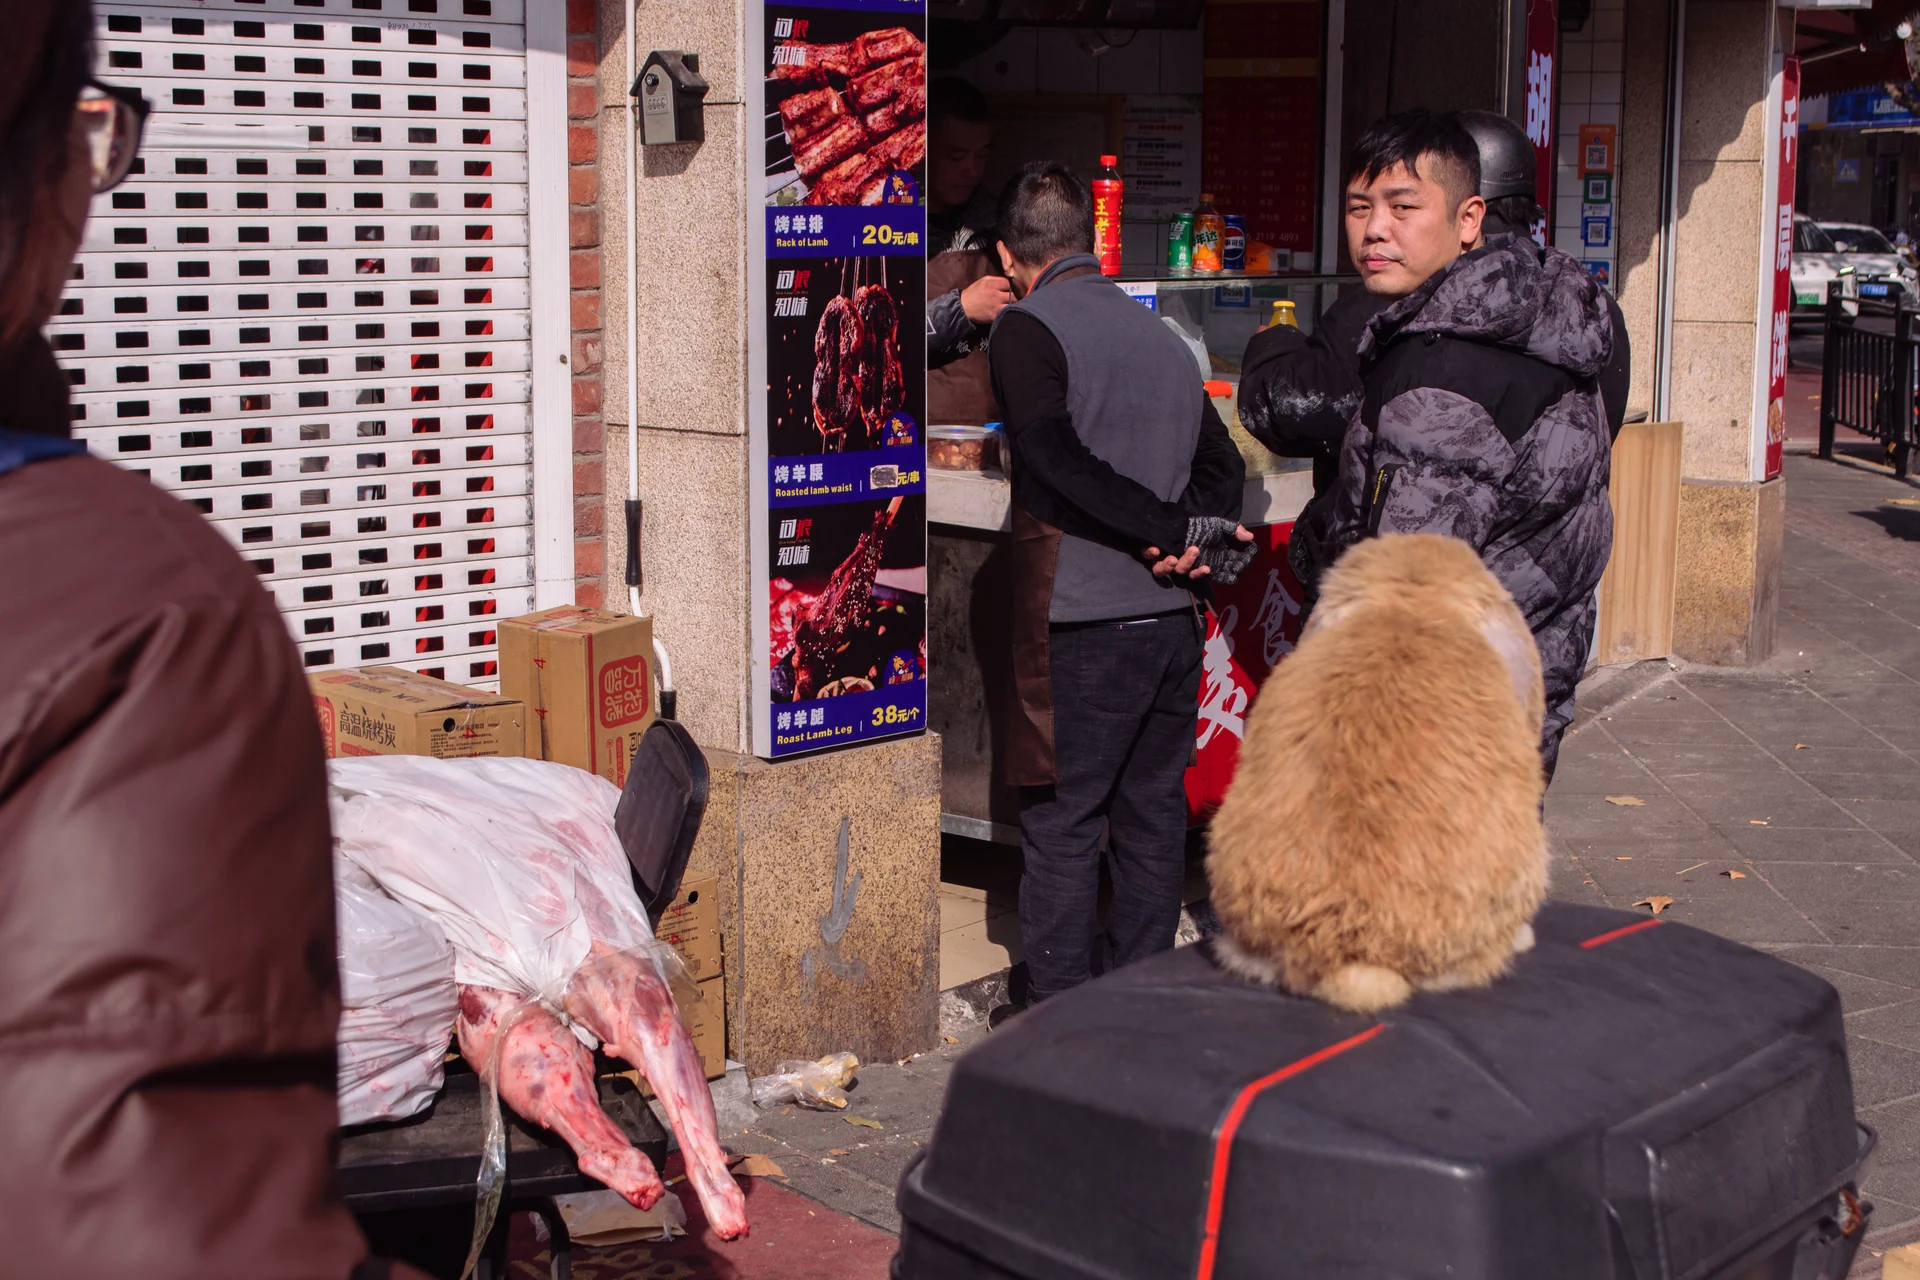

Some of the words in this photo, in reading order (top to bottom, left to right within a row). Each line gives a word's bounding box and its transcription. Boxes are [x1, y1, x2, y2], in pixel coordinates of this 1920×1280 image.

[774, 17, 809, 40] 问狼
[772, 45, 806, 66] 知味
[774, 214, 824, 234] 烤羊排
[776, 238, 796, 247] Rack
[798, 238, 806, 247] of
[807, 238, 828, 247] Lamb
[862, 224, 919, 246] 20元/串
[775, 270, 811, 294] 问狼
[773, 297, 808, 317] 知味
[774, 463, 824, 484] 烤羊腰
[897, 471, 920, 485] 元/串
[775, 486, 809, 497] Roasted
[810, 486, 830, 495] lamb
[831, 483, 853, 493] waist
[779, 518, 813, 542] 问狼
[776, 545, 810, 566] 知味
[777, 707, 825, 730] 烤羊腿
[871, 704, 920, 726] 38元/个
[340, 710, 396, 748] 高温烧烤炭
[777, 733, 804, 745] Roast
[807, 728, 833, 741] Lamb
[835, 724, 853, 736] Leg
